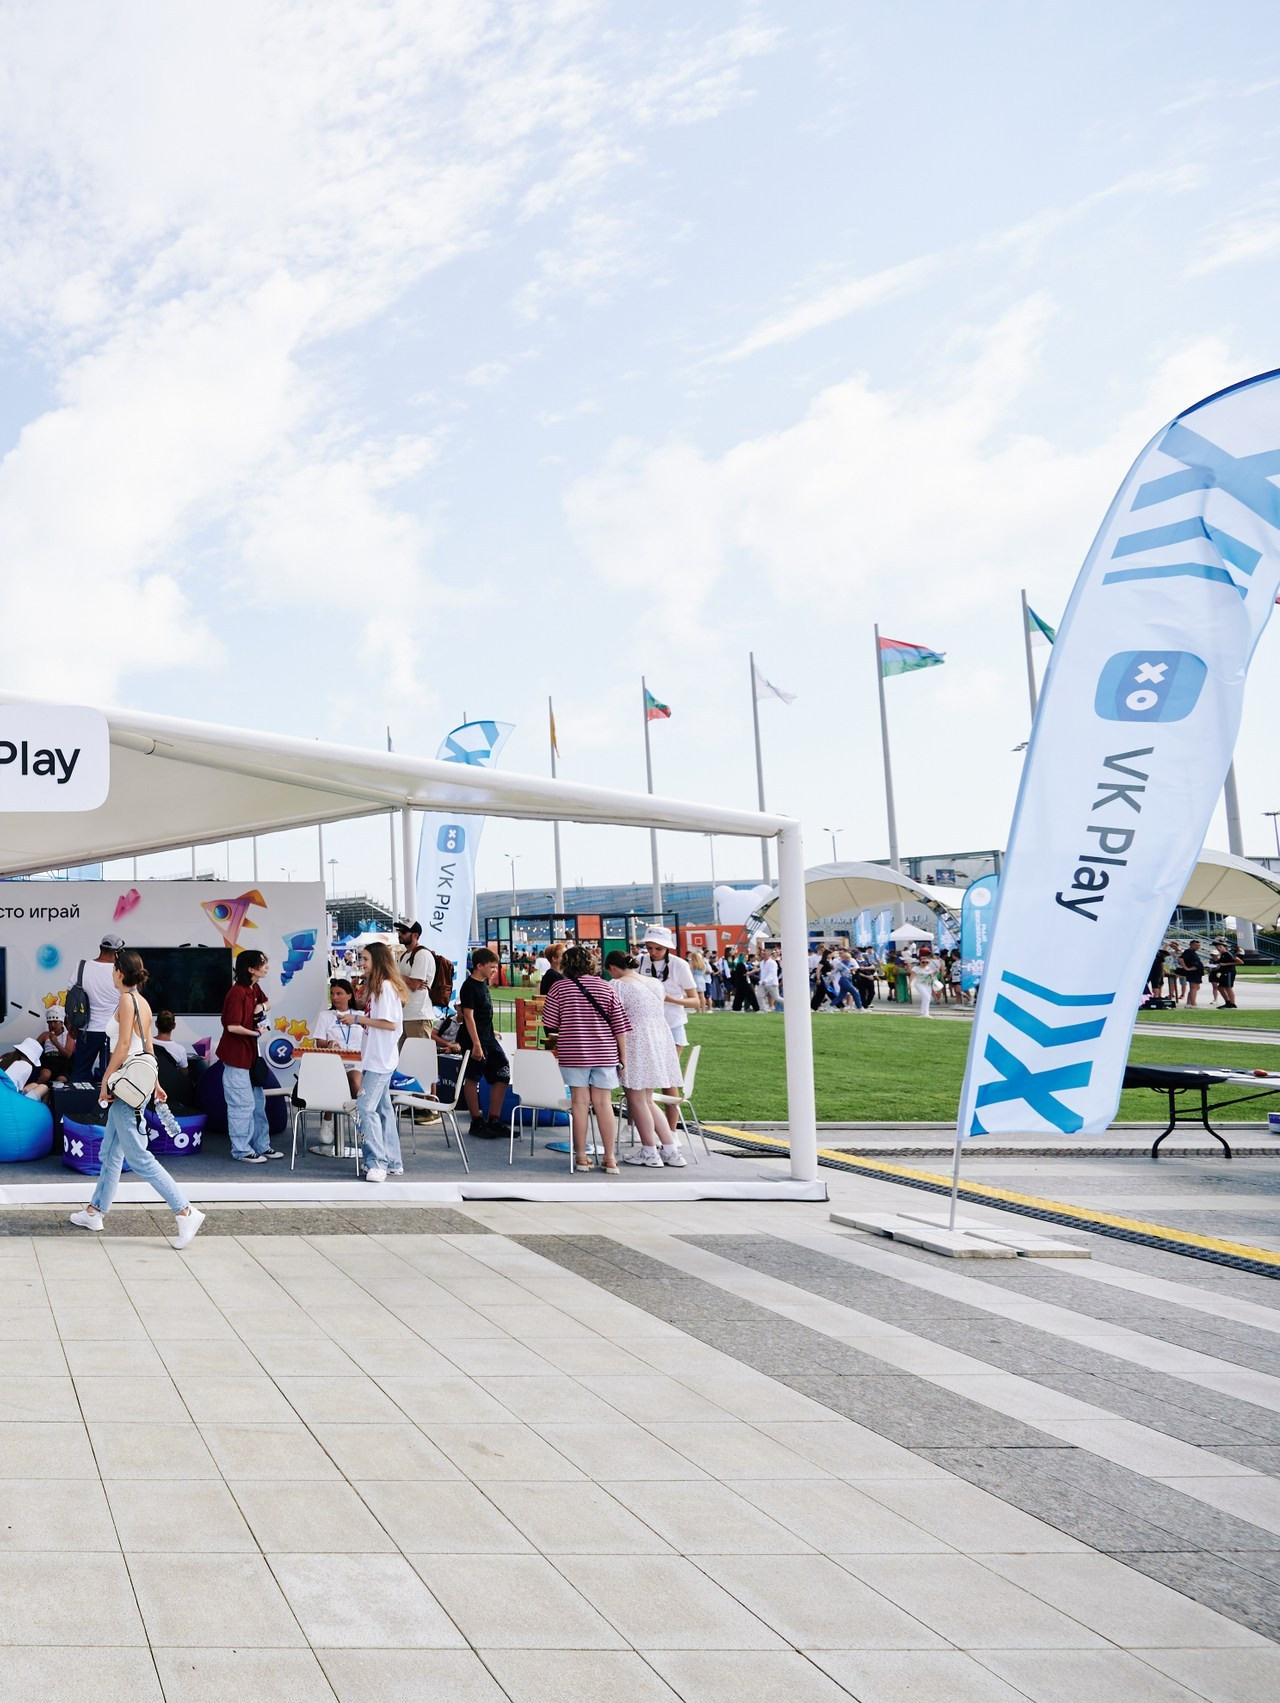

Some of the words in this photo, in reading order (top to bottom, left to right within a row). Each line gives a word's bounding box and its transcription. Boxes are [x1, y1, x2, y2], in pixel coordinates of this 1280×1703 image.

[1091, 746, 1155, 815] VK
[438, 863, 456, 889] VK
[1055, 825, 1136, 922] Play
[29, 904, 80, 922] играй
[430, 894, 451, 933] Play
